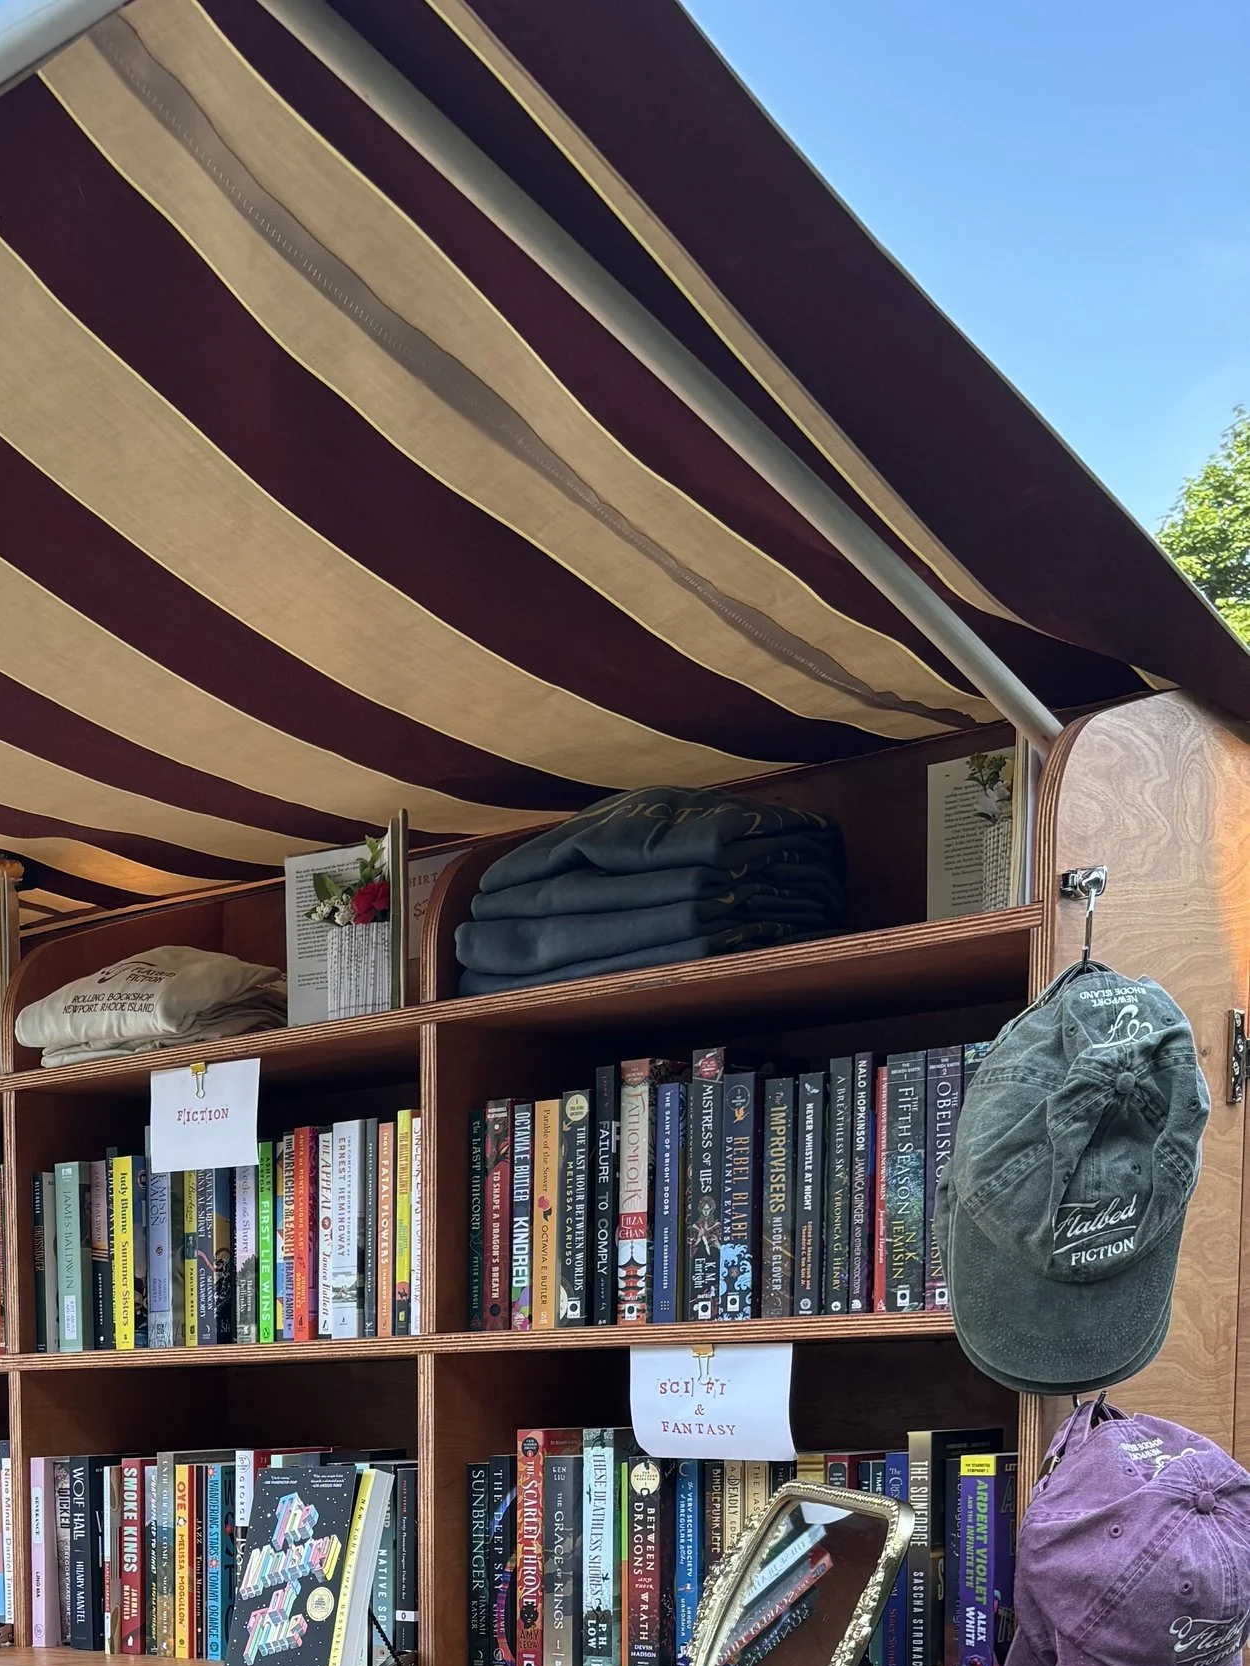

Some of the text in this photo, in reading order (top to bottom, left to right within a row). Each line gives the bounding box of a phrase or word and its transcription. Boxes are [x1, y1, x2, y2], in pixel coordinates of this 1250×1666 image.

[73, 993, 155, 1003] ROLLING BOOKSHOP
[100, 1003, 127, 1012] RHODE
[127, 1003, 155, 1012] ISLAND
[1080, 987, 1146, 999] RHODE ISLAND
[177, 1108, 229, 1124] FICTION
[542, 1109, 551, 1138] Parable
[577, 1126, 586, 1146] THE
[664, 1139, 670, 1150] OF
[853, 1060, 867, 1224] NALO HOPKINSON JAMAICA GINGER
[542, 1166, 550, 1192] Sower
[576, 1148, 585, 1171] LAST
[804, 1103, 814, 1210] NEVER WHISTLE AT NIGHT
[897, 1086, 915, 1215] FIFTH SEASON
[337, 1137, 347, 1258] ERNEST HEMINGWAY
[512, 1112, 530, 1288] OCTAVIA BUTLER KINDRED
[575, 1174, 585, 1201] HOUR
[597, 1121, 609, 1275] FAILURE TO COMPLY
[723, 1136, 734, 1242] DAVINIA EVANS
[731, 1136, 750, 1240] REBEL BLADE
[769, 1106, 786, 1291] IMPROVISERS NICOLE GLOVER
[832, 1088, 846, 1291] BREATHLESS SKY VERONICA HENRY
[63, 1191, 74, 1289] JAMES BALDWIN
[242, 1220, 251, 1253] Shore
[574, 1204, 585, 1249] BETWEEN
[1052, 1194, 1137, 1241] Flatbed
[119, 1172, 130, 1326] Judy Blume Summer Sisters
[261, 1201, 270, 1321] FIRST LIE WINS
[574, 1252, 584, 1291] WORLDS
[892, 1220, 904, 1279] JEMISIN
[1071, 1236, 1135, 1265] FICTION
[661, 1421, 736, 1435] FANTASY
[695, 1404, 704, 1415] &
[123, 1468, 137, 1573] SMOKE KINGS
[357, 1498, 366, 1520] NEW
[712, 1469, 721, 1528] BINDLEPUNK
[73, 1467, 85, 1623] WOLF HALL HILARY MANTEL
[209, 1479, 219, 1638] WANDERING STARS TOMMY ORANGE
[350, 1528, 360, 1557] YORK
[471, 1469, 485, 1590] SUNBRINGER
[493, 1512, 504, 1592] DEEP SKY
[646, 1508, 656, 1571] BETWEEN
[975, 1480, 988, 1605] ARDENT VIOLET
[633, 1502, 648, 1641] DRAGONS WRATH
[587, 1619, 597, 1649] LOW
[965, 1607, 975, 1647] WHITE
[977, 1611, 986, 1642] ALEX
